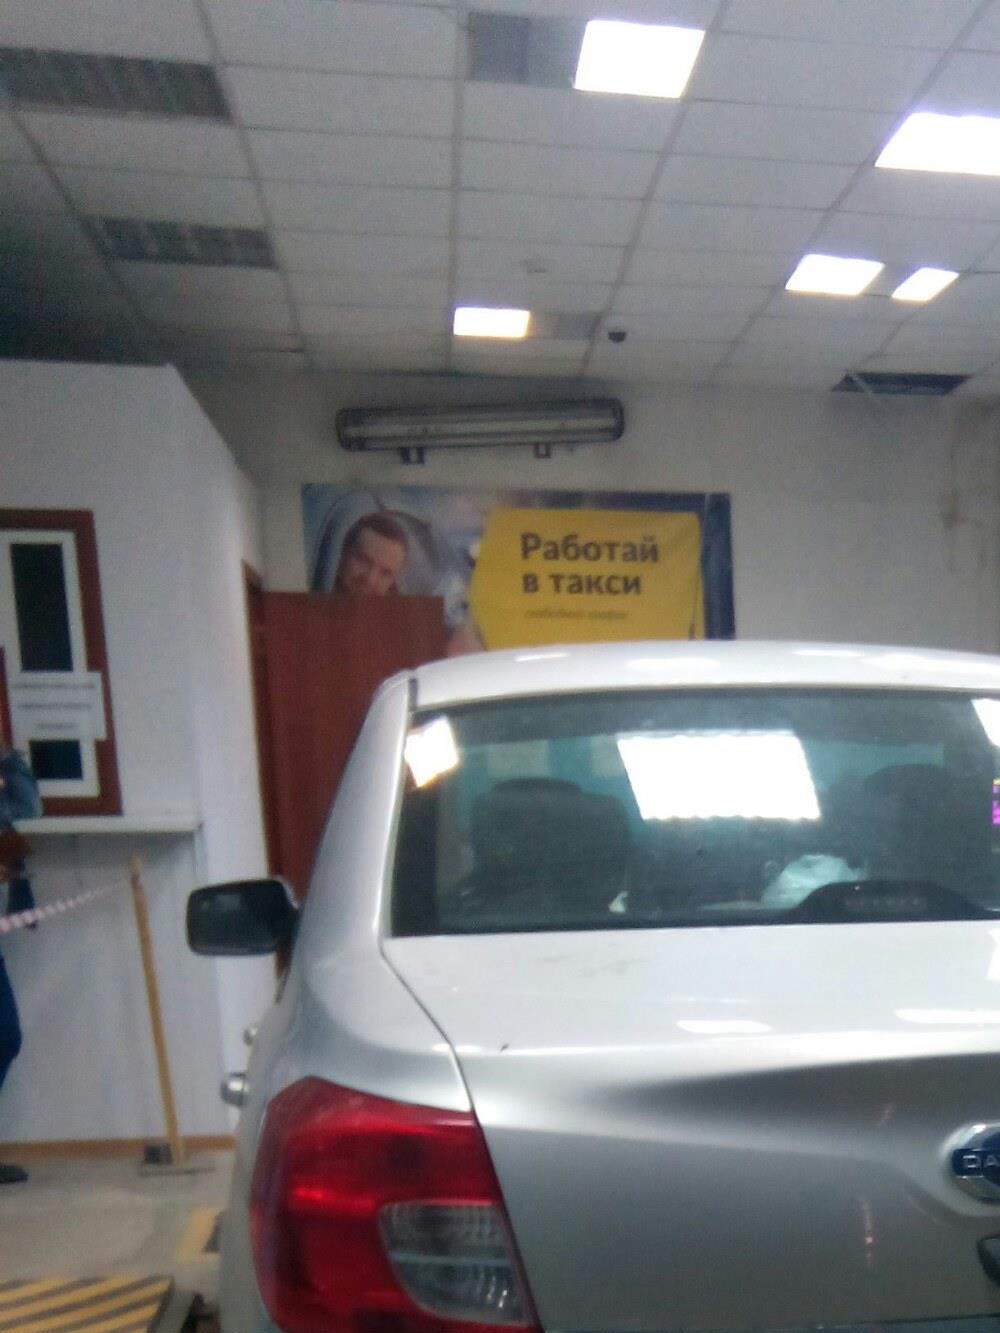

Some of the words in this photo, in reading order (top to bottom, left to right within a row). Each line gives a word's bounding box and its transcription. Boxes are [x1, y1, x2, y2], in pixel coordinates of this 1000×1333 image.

[520, 532, 658, 562] Работай
[523, 573, 539, 593] в
[549, 574, 641, 595] такси
